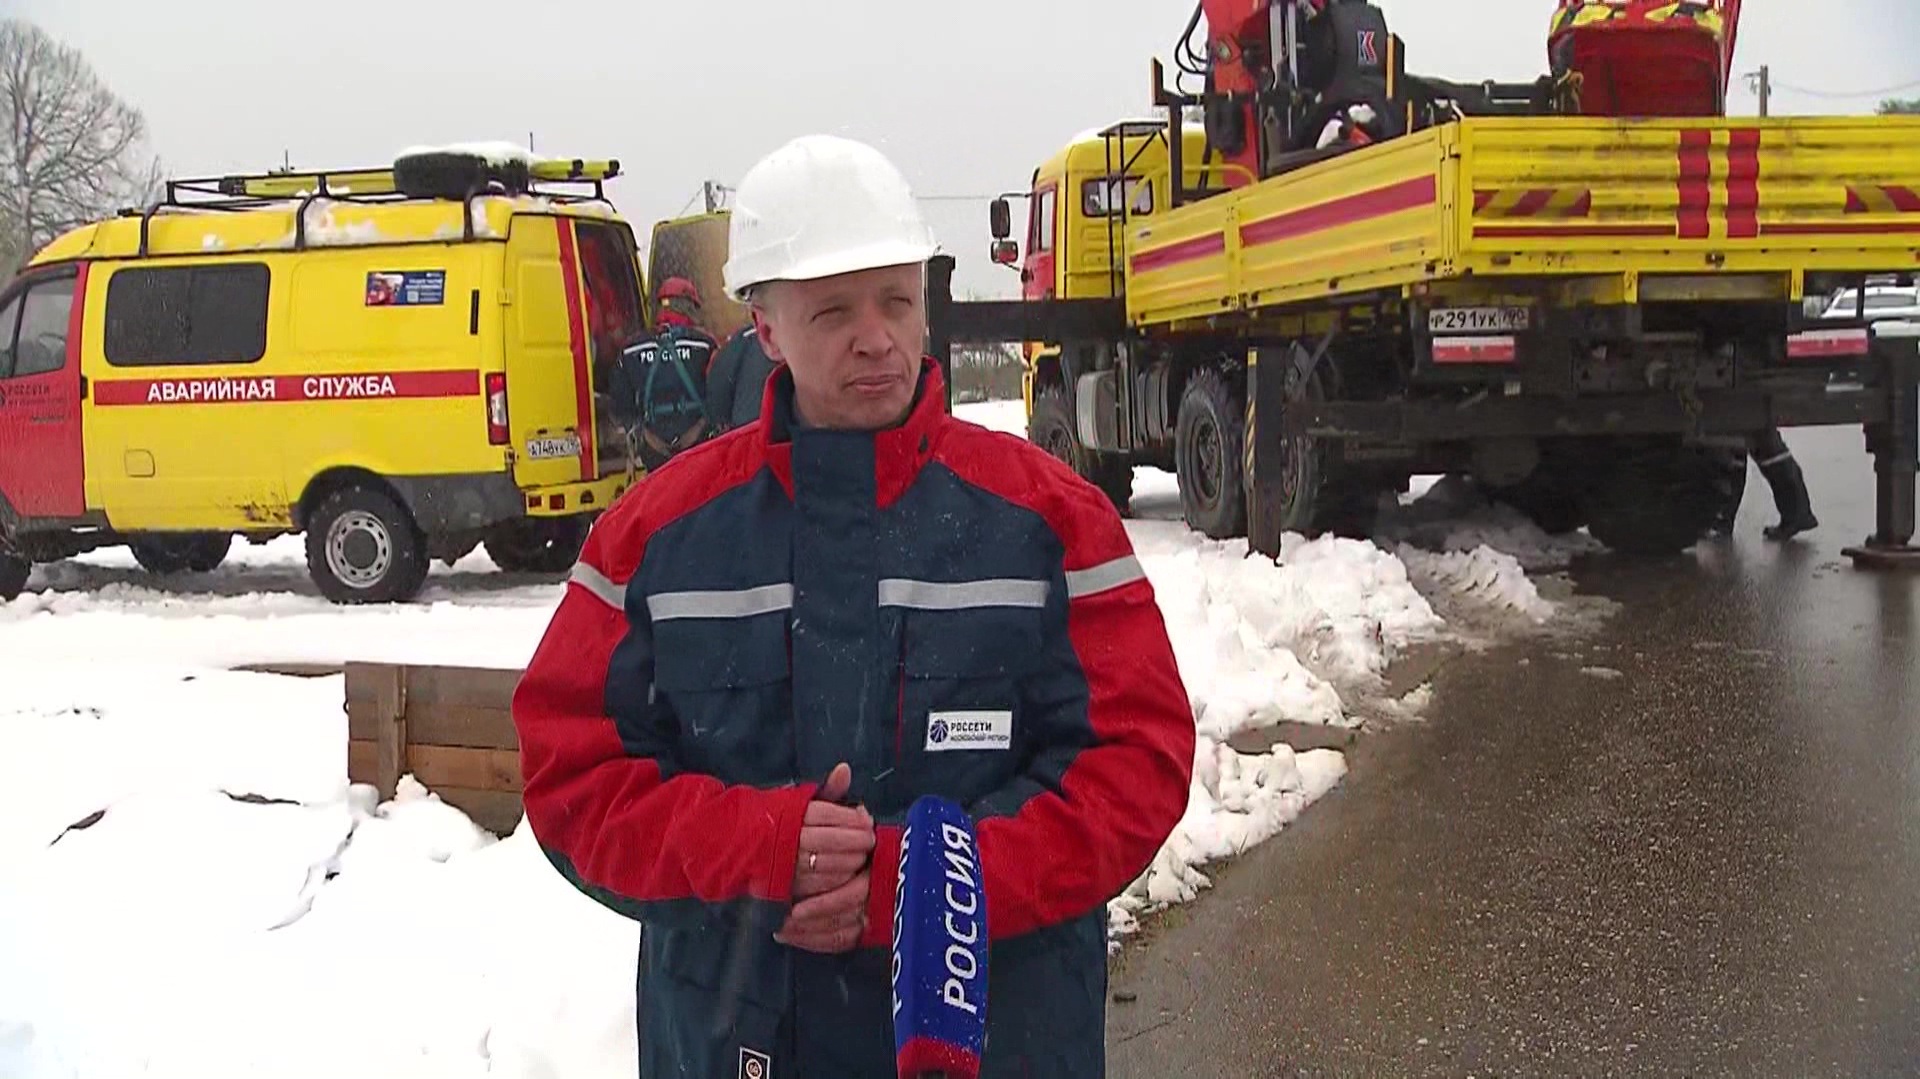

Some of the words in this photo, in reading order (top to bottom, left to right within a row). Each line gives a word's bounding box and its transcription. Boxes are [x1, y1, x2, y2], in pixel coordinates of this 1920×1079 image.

[147, 377, 276, 402] АВАРИЙНАЯ
[303, 374, 397, 399] СЛУЖБА
[950, 722, 992, 732] РОССЕТИ
[941, 823, 978, 1013] РОССИЯ
